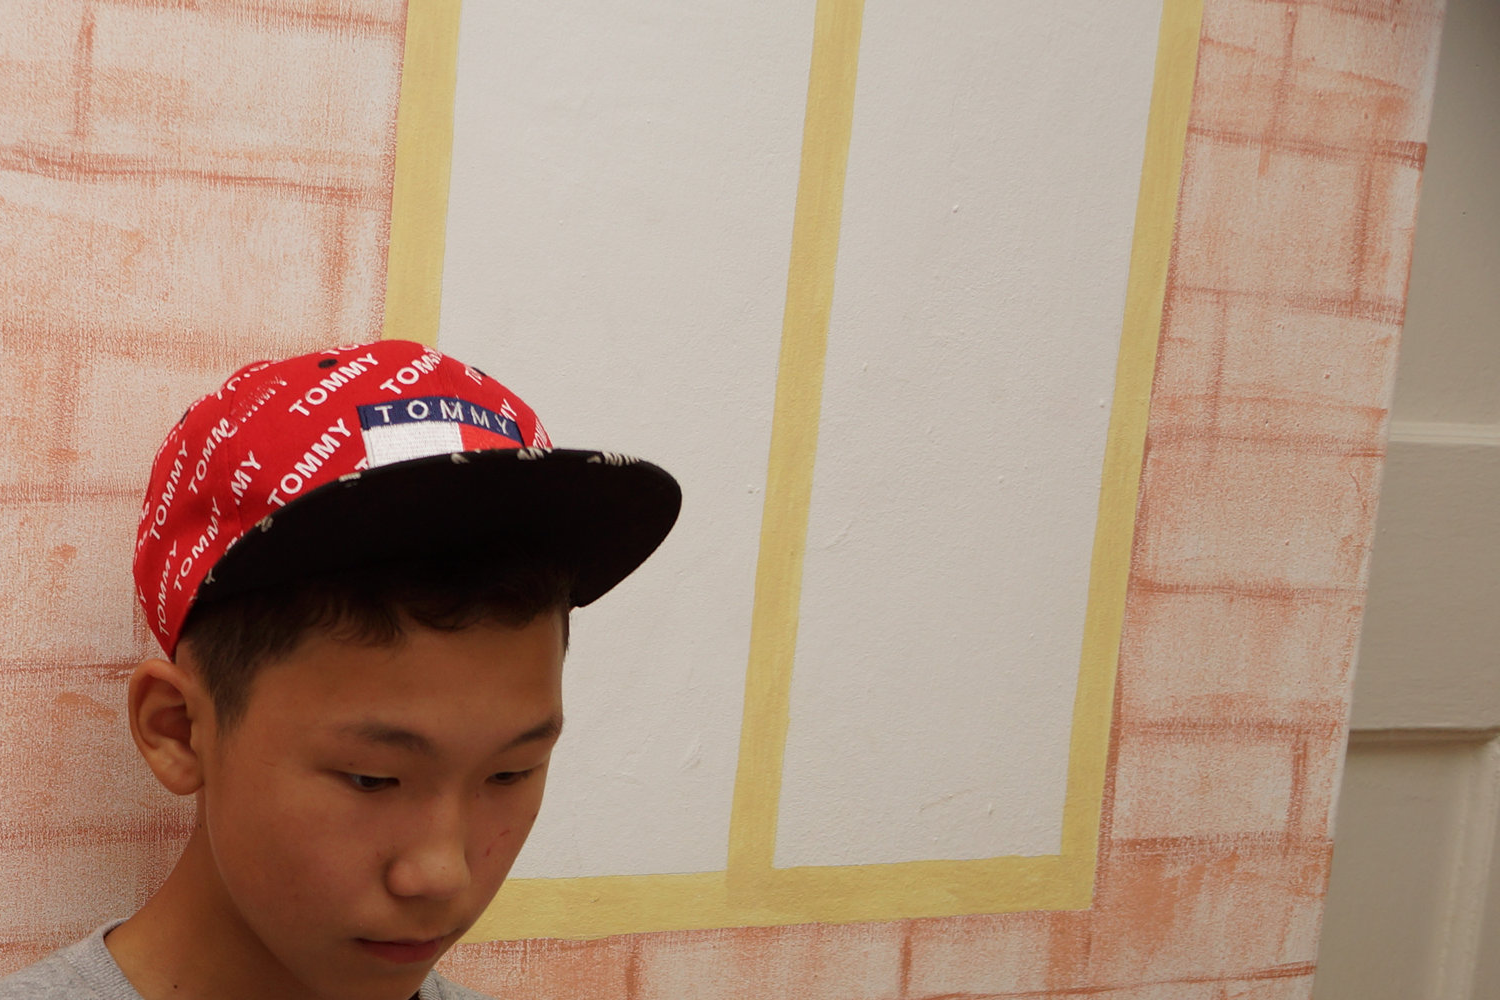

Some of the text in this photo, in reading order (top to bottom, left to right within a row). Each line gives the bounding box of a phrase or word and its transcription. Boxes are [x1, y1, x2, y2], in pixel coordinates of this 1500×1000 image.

[289, 353, 379, 416] TOMMY
[374, 399, 509, 435] TOMMY
[149, 440, 188, 540] TOMMY
[188, 417, 230, 494] TOMM
[266, 418, 351, 507] TOMMY
[157, 540, 177, 636] TOMMY
[173, 496, 221, 591] TOMMY
